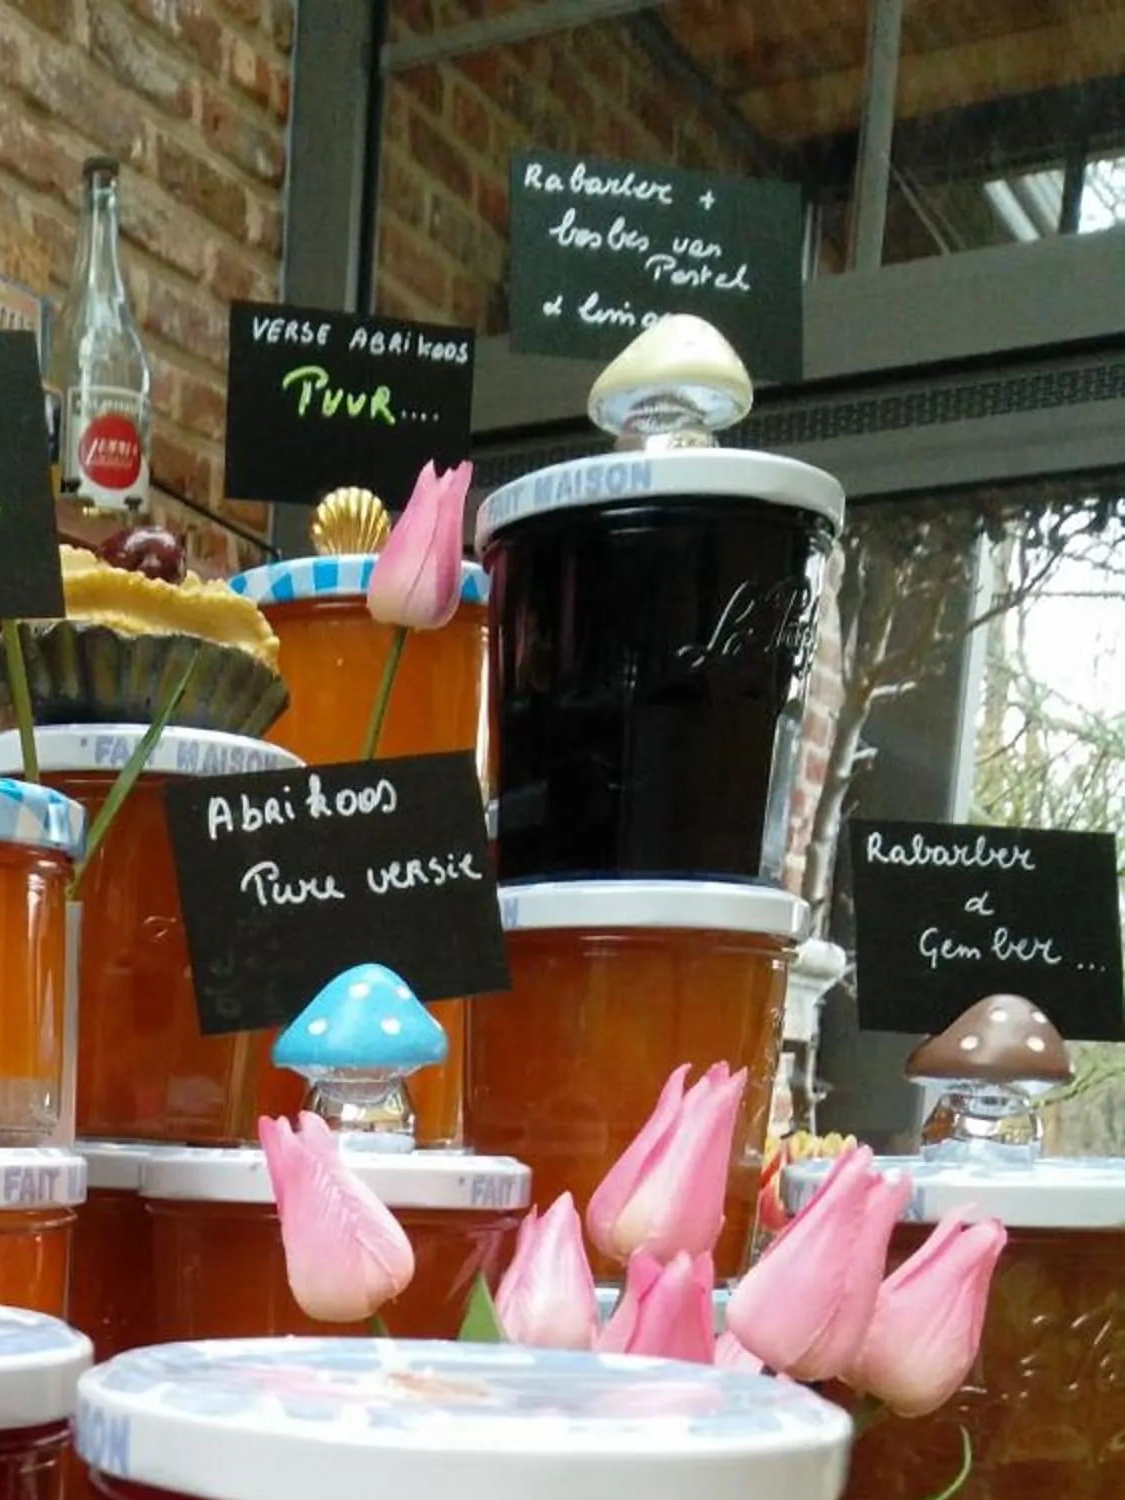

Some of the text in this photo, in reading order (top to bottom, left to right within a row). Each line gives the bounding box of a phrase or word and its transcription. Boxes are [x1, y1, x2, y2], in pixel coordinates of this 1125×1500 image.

[253, 316, 331, 346] VERSE
[208, 773, 397, 840] Abrikoos
[867, 832, 1036, 870] Rabarber
[367, 853, 482, 893] versie
[4, 1165, 60, 1201] FAIT
